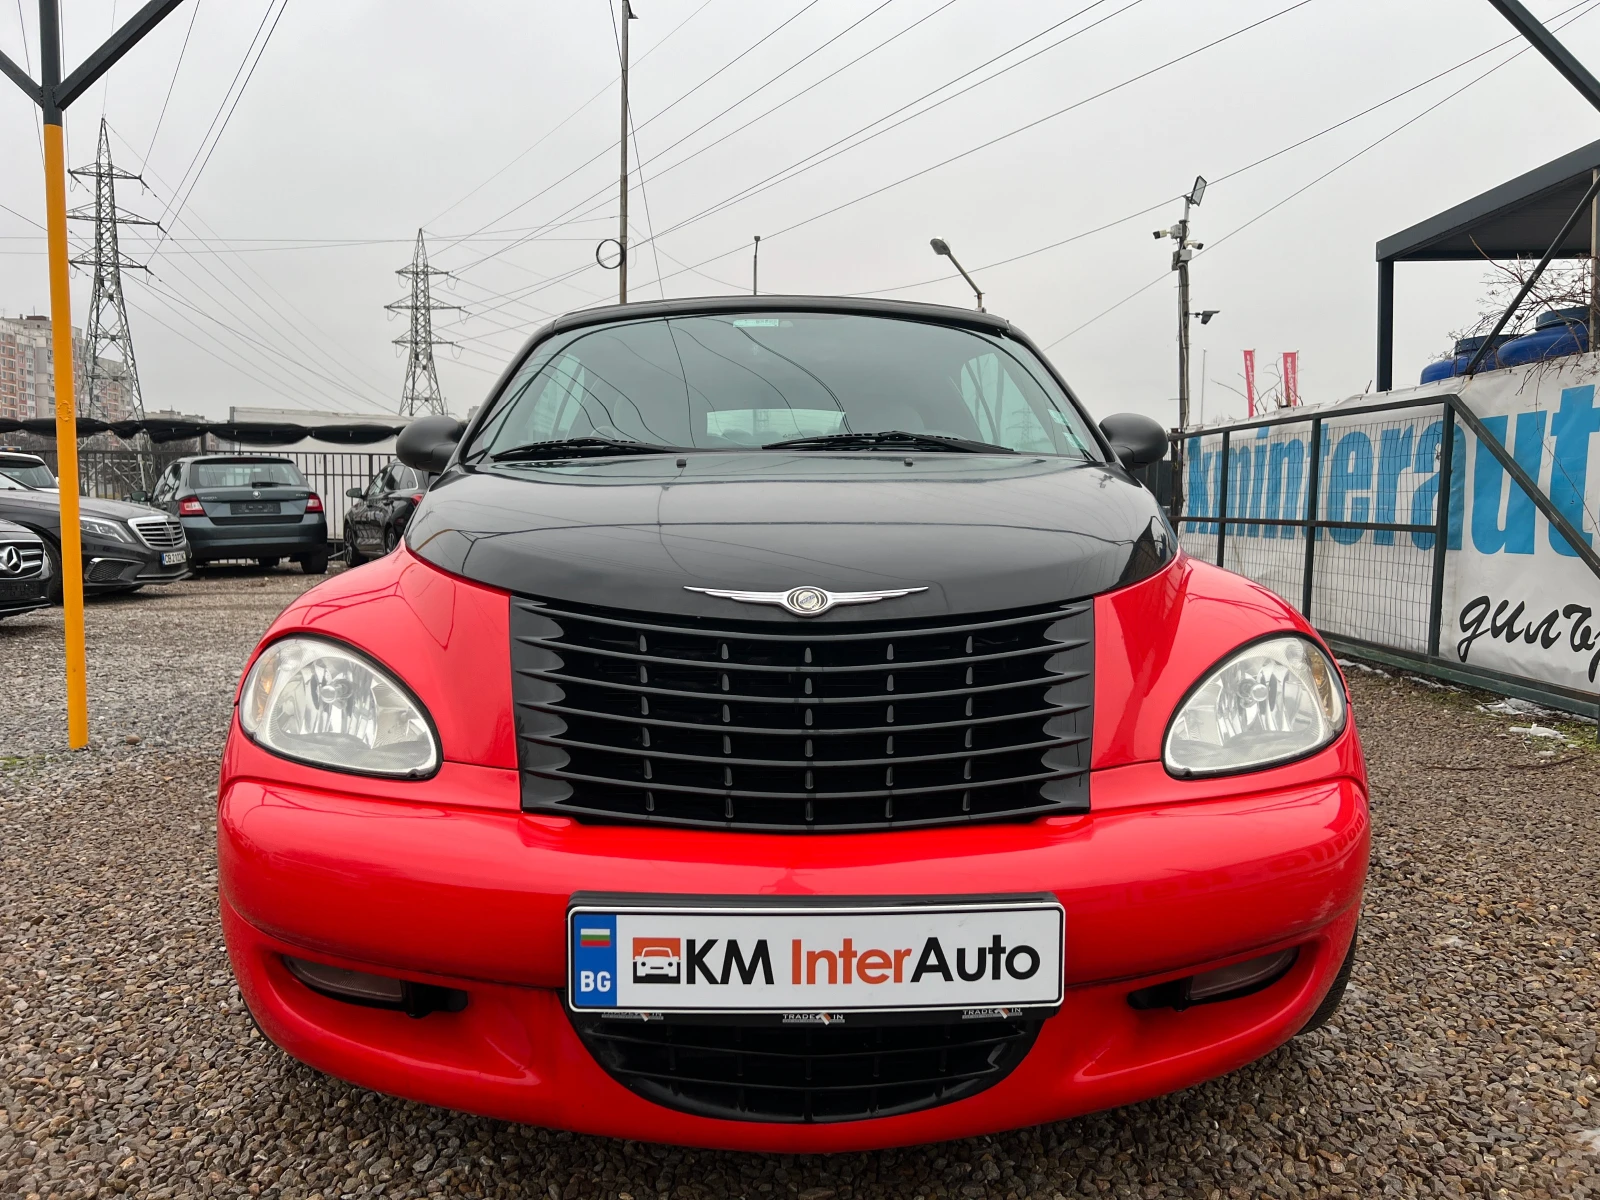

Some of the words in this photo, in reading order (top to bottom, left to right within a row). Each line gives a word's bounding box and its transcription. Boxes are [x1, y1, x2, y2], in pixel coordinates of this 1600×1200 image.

[1186, 384, 1600, 557] kminteraut
[580, 970, 611, 992] BG
[686, 939, 774, 984] KM
[792, 934, 1041, 985] InterAuto
